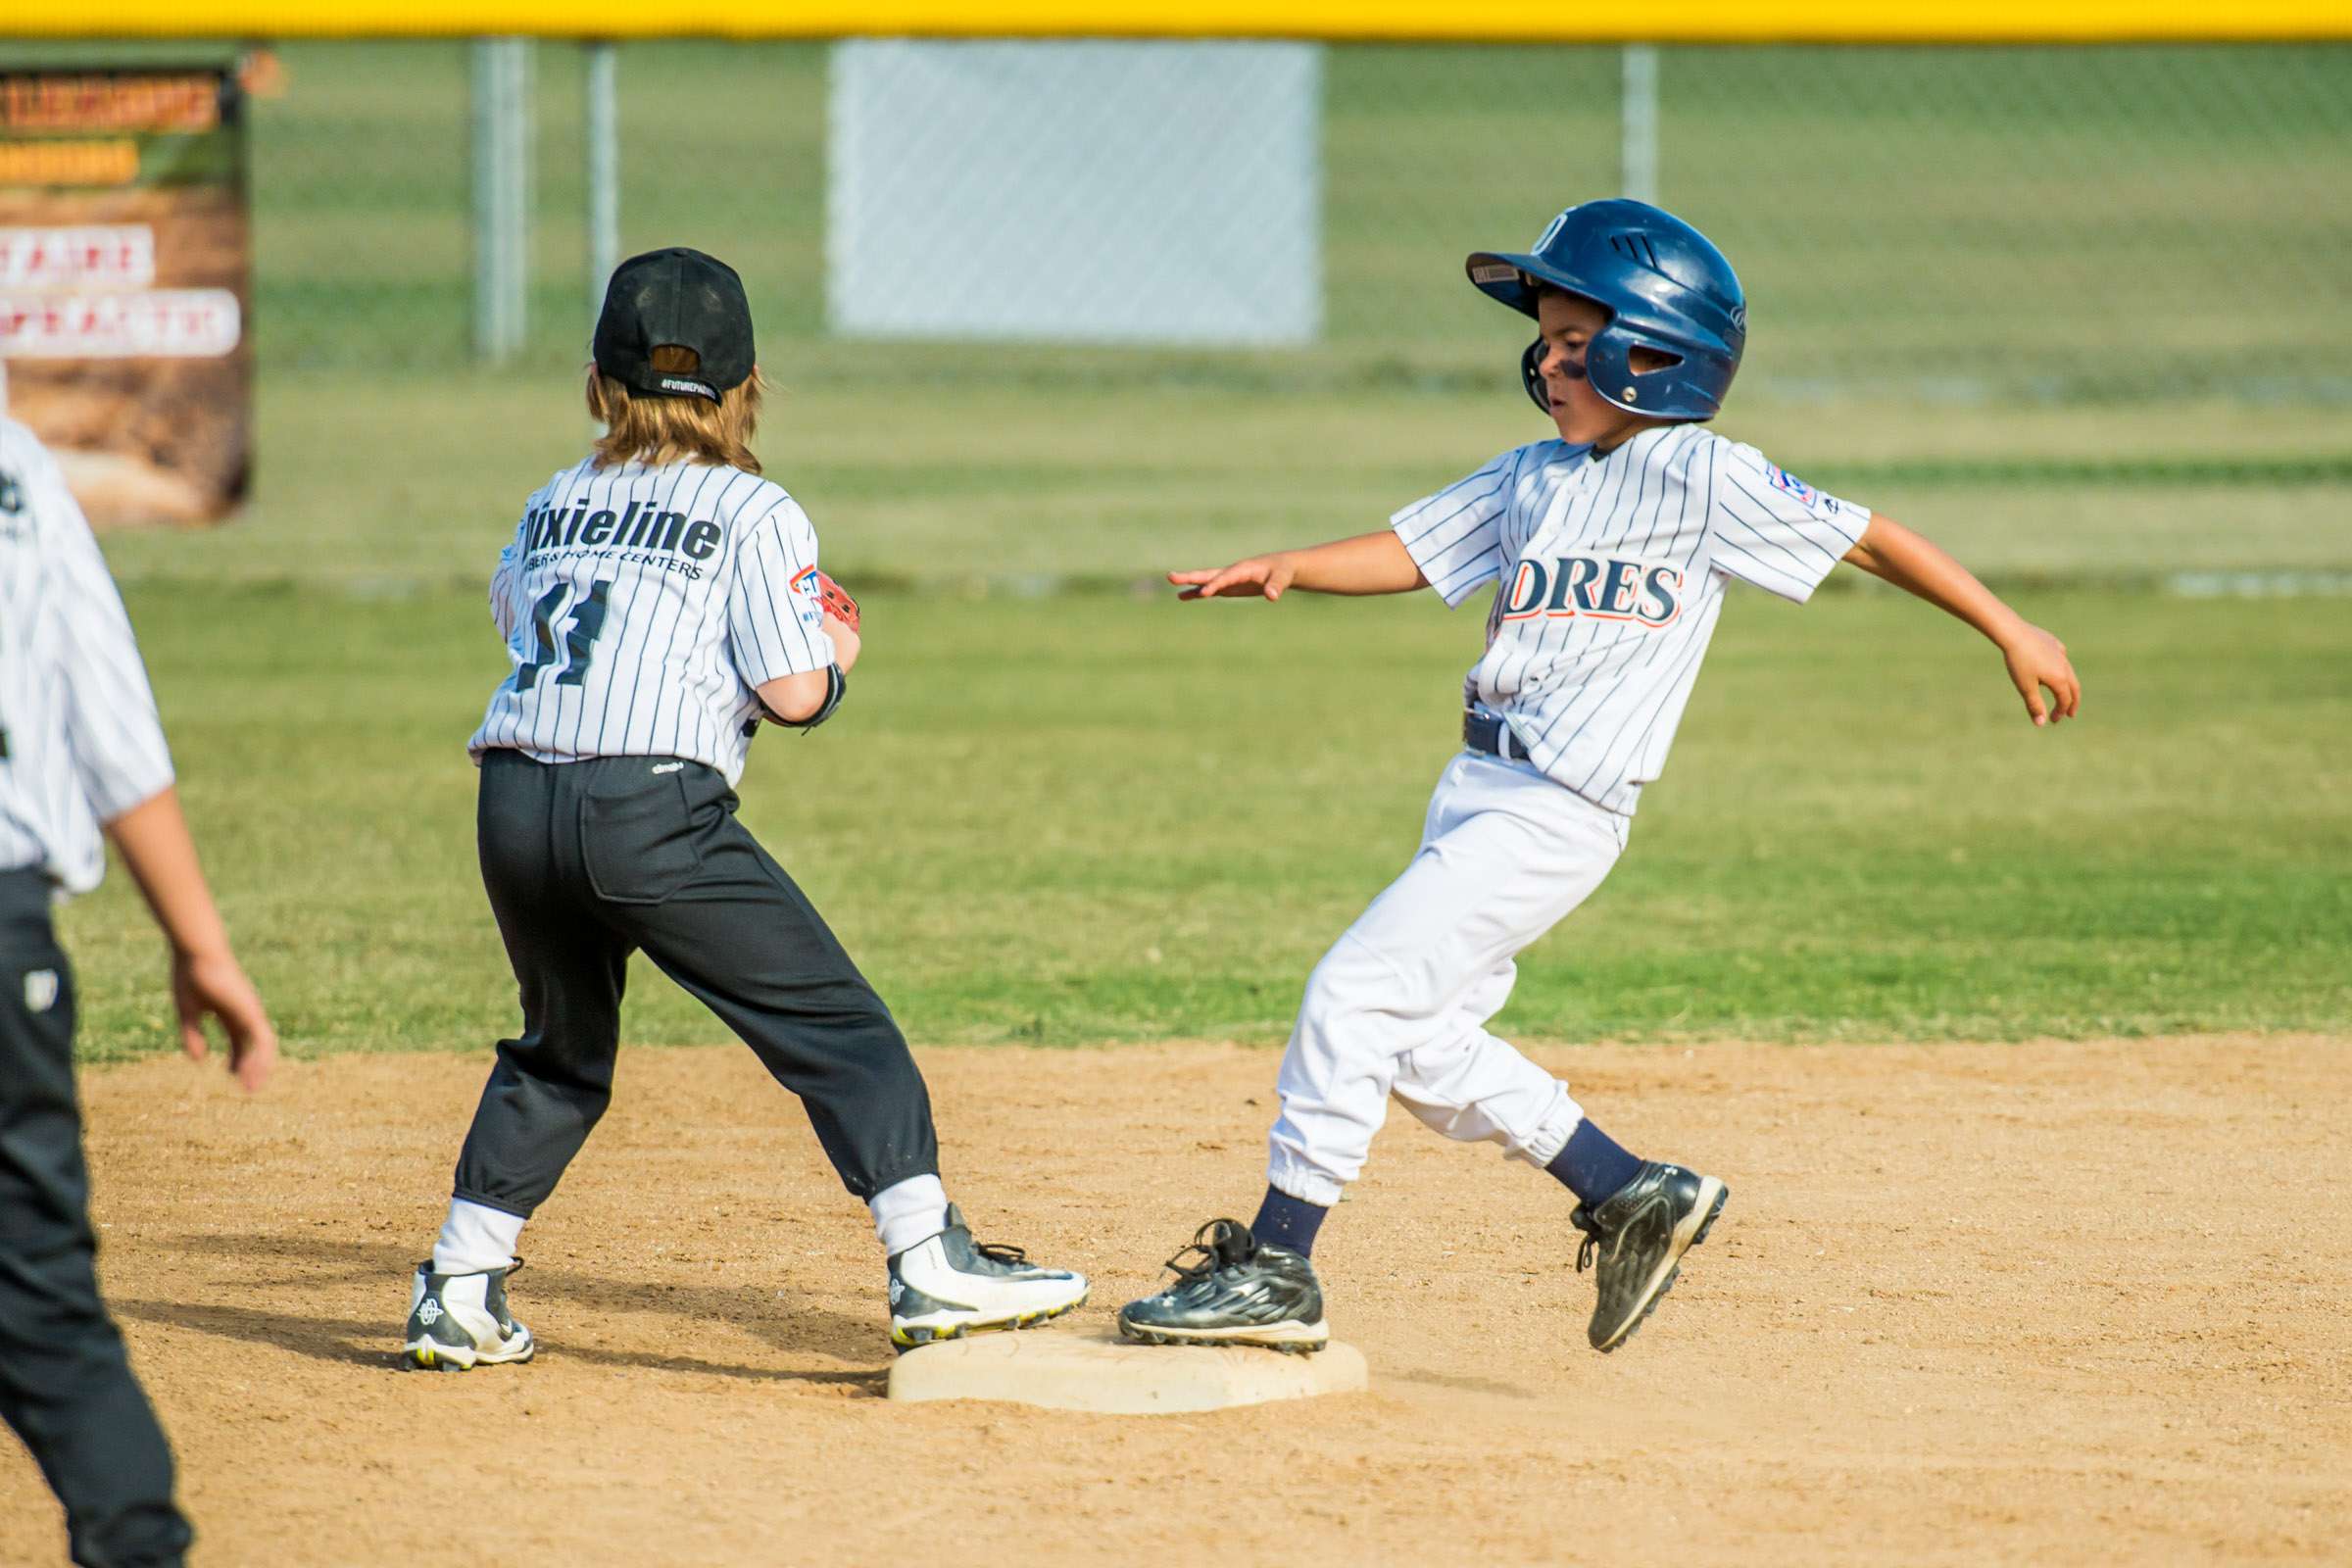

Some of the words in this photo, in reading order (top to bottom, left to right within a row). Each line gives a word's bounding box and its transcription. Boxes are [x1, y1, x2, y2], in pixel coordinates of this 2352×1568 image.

[563, 549, 617, 561] HOME
[619, 551, 704, 580] CENTERS
[515, 579, 612, 693] 11
